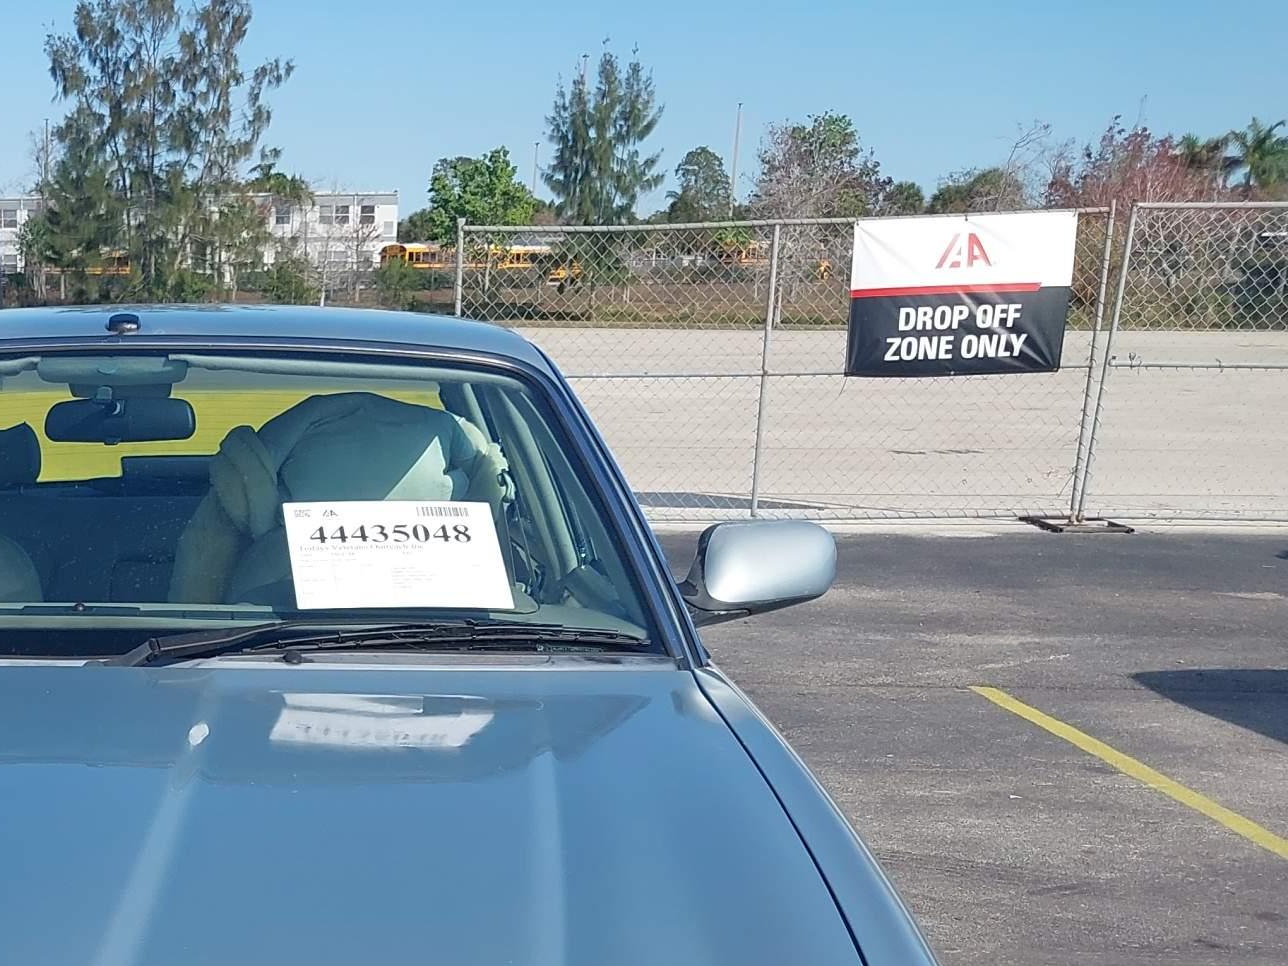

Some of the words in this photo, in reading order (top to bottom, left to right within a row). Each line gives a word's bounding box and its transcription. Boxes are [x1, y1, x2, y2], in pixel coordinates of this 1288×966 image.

[898, 305, 969, 332] DROP
[975, 303, 1022, 329] OFF
[883, 335, 955, 362] ZONE
[960, 333, 1028, 359] ONLY
[309, 523, 472, 544] 44435048
